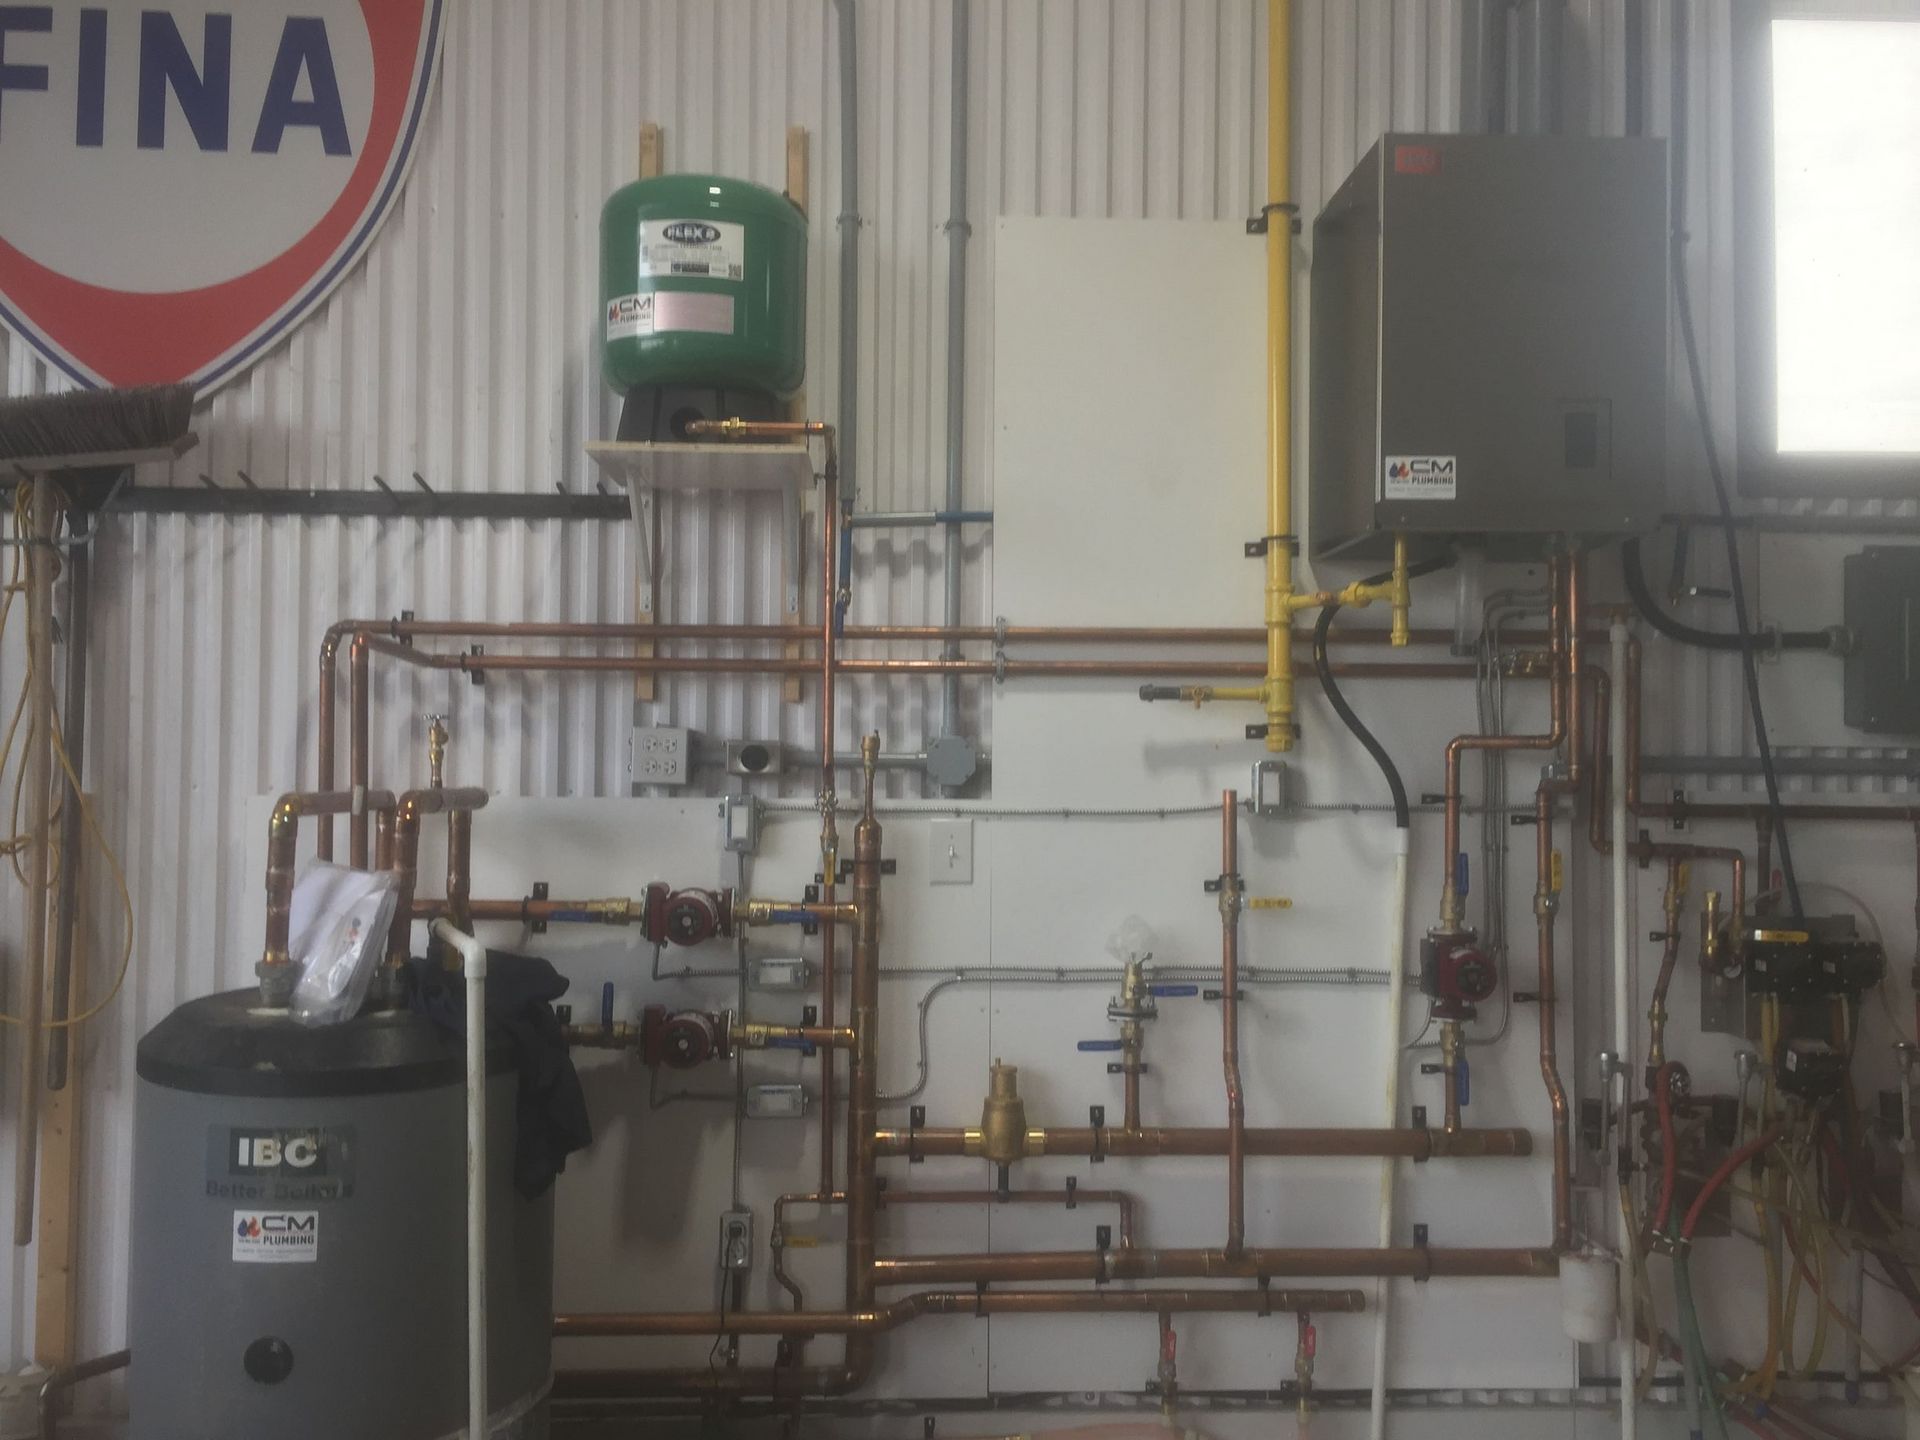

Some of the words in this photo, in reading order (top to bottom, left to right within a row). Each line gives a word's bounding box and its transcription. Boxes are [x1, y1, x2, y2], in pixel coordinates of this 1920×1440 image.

[0, 5, 352, 157] FINA
[619, 298, 651, 313] CM
[1410, 459, 1453, 473] CM
[1411, 476, 1453, 485] PLUMBING
[238, 1137, 318, 1168] IBC
[206, 1180, 266, 1199] Better
[262, 1214, 315, 1232] CM
[263, 1235, 315, 1246] PLUMBING
